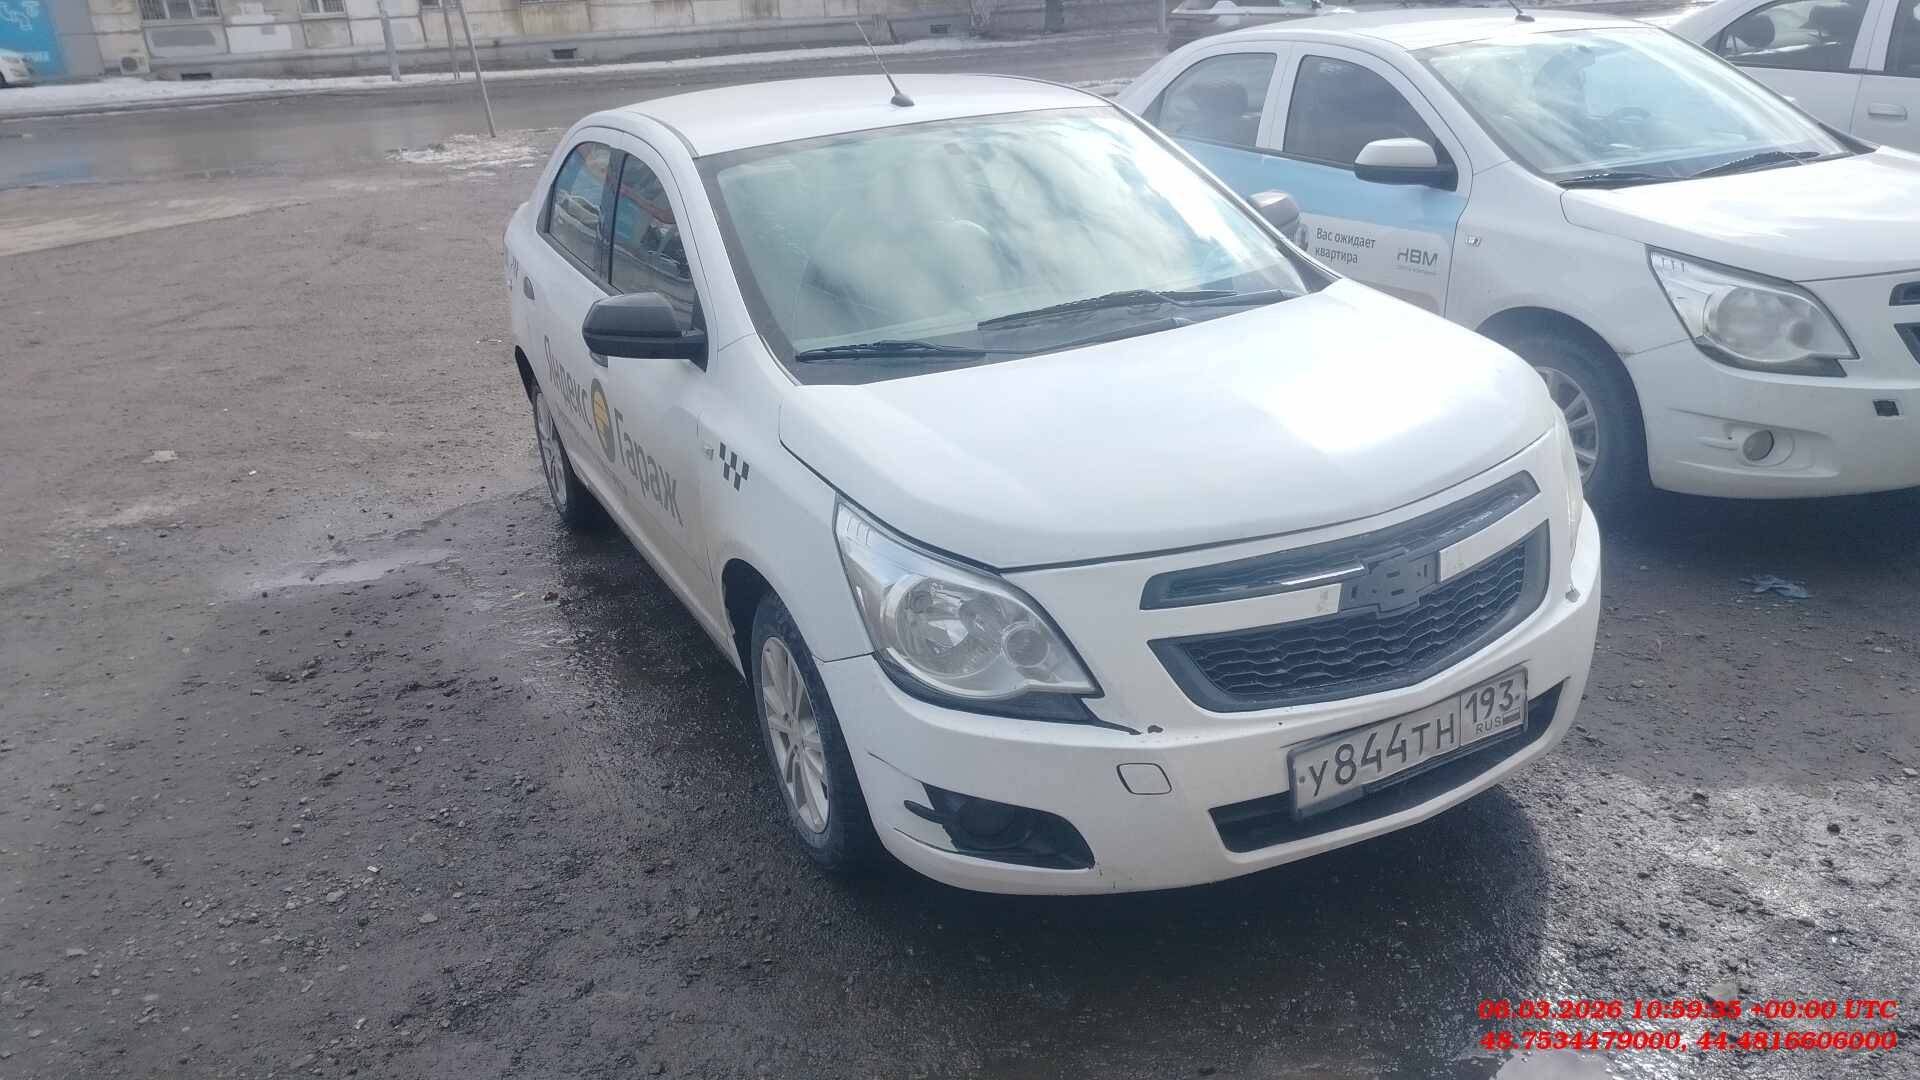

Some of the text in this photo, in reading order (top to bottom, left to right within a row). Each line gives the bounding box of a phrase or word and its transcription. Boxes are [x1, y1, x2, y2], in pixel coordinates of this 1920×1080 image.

[1316, 227, 1376, 249] Вас ожидает
[1315, 247, 1358, 264] квартира
[544, 335, 593, 430] Яндекс
[614, 407, 684, 527] Гараж
[1476, 716, 1502, 735] RUS
